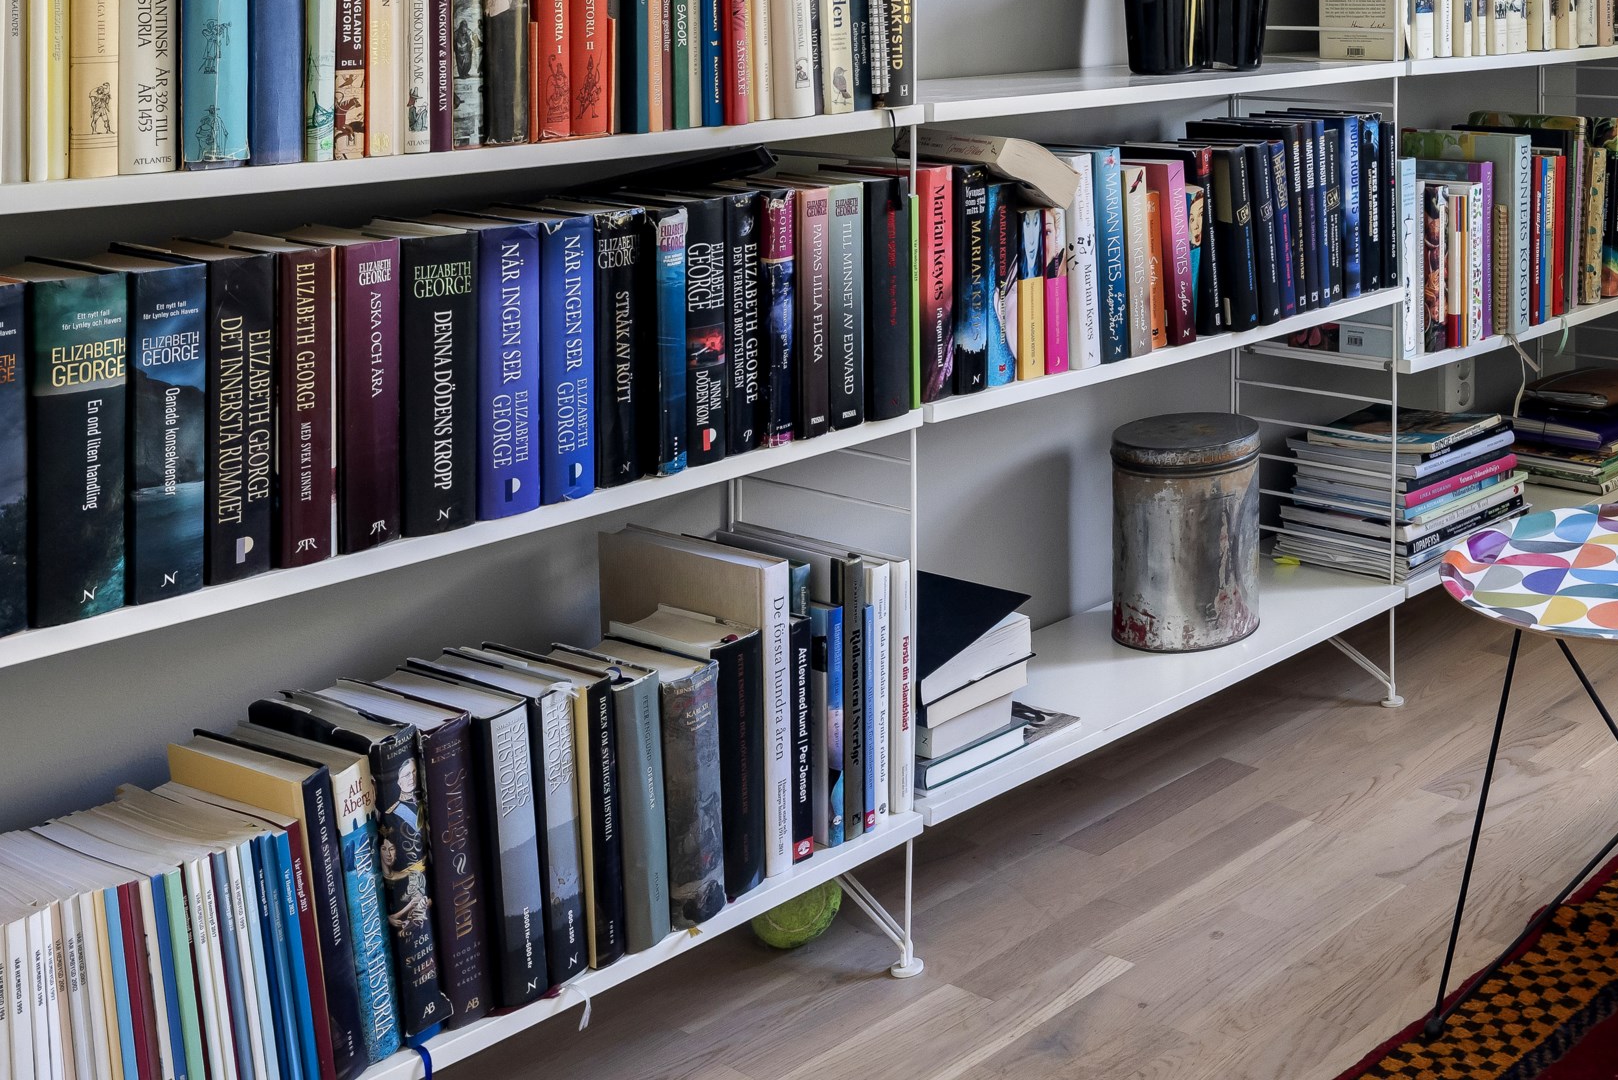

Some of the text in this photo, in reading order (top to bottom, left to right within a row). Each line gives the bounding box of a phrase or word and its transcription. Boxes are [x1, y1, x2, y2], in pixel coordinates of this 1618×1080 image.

[677, 4, 687, 47] SAGOR
[155, 89, 168, 147] 326 TILL
[133, 155, 172, 166] ATLANTIS
[971, 220, 982, 284] MARIAN
[1105, 173, 1122, 282] MARIAN KEYES
[1520, 145, 1529, 325] BONNIERS KOKBOK
[413, 261, 472, 281] ELIZABETH
[413, 276, 472, 299] GEORGE
[564, 234, 585, 373] NÄR INGEN SER
[687, 242, 712, 313] GEORGE
[710, 242, 724, 310] ELIZABETH
[813, 224, 822, 311] PAPPAS LILLA
[142, 331, 200, 352] ELIZABETH
[370, 291, 383, 399] ASKA OCH ÄRA
[501, 242, 524, 385] NÄR INGEN SER
[733, 265, 744, 390] VERKLIGA BROTTSLINGEN
[744, 242, 758, 405] ELIZABETH GEORGE
[842, 253, 854, 395] MINNET EDWARD
[51, 337, 126, 365] ELIZABETH
[51, 356, 126, 387] GEORGE
[142, 344, 200, 367] GEORGE
[296, 263, 316, 465] ELIZABETH GEORGE SVEK
[617, 361, 632, 403] RÖTT
[218, 316, 243, 524] DET INNERSTA RUMMET
[247, 329, 271, 503] ELIZABETH GEORGE
[434, 309, 456, 490] DENNA DÖDENS KROPP
[492, 394, 512, 470] GEORGE
[515, 389, 529, 463] ELIZABETH
[556, 381, 575, 456] GEORGE
[576, 377, 588, 449] ELIZABETH
[710, 380, 722, 411] INNAN
[82, 463, 100, 511] handling
[773, 620, 787, 723] första hundra
[511, 722, 531, 808] SVERIGES
[559, 700, 575, 784] SVERIGES
[342, 790, 371, 817] Åberg
[354, 838, 394, 1041] VÅR SVENSKA HISTORIA
[453, 874, 477, 940] Polen
[413, 957, 435, 974] HELA
